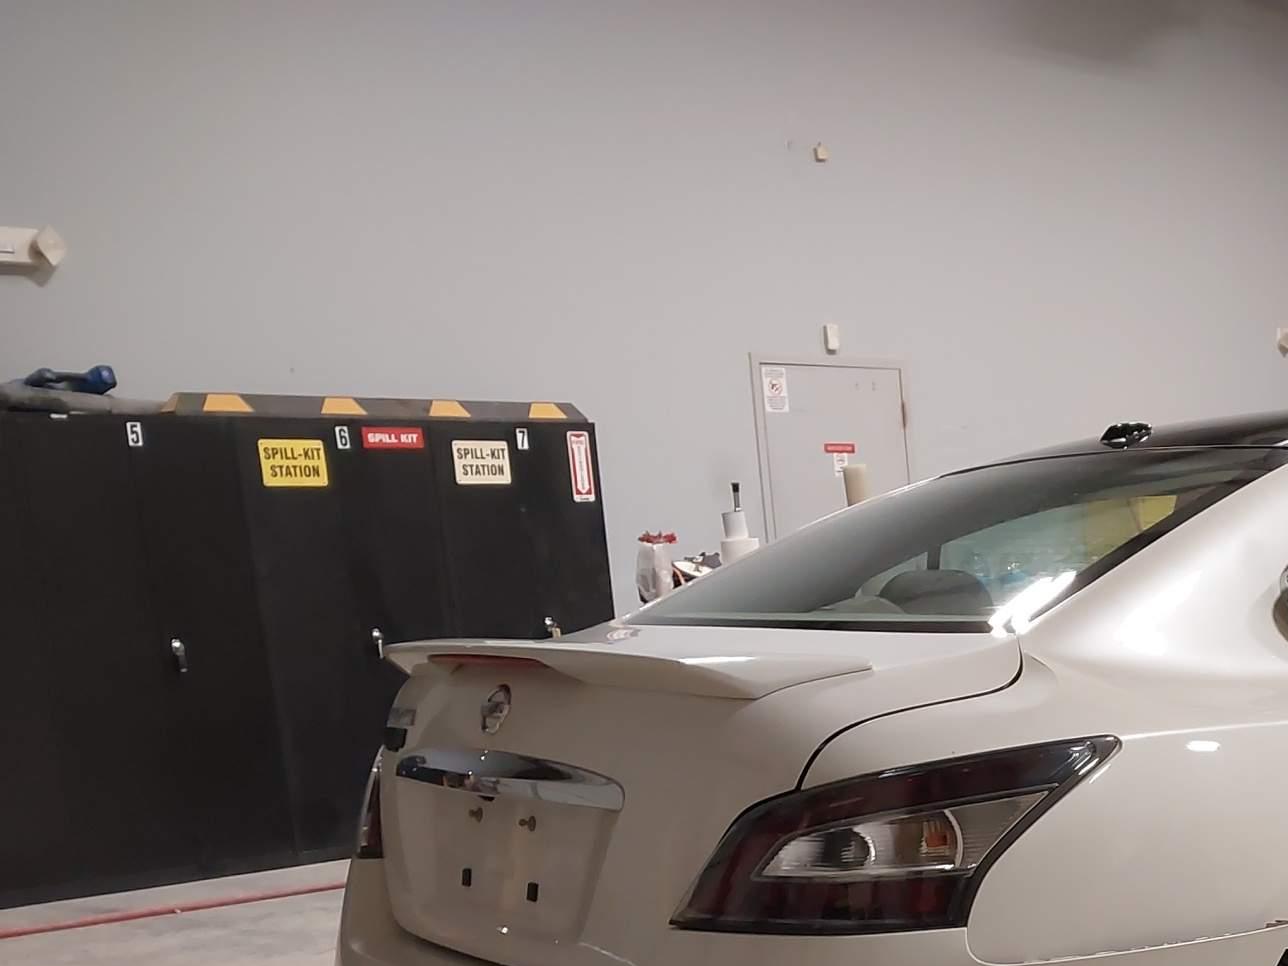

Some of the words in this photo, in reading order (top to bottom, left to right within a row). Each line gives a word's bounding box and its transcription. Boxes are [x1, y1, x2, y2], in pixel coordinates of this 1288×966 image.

[130, 423, 140, 445] 5
[338, 428, 349, 447] 6
[368, 433, 398, 443] SPILL
[400, 434, 418, 443] KIT
[518, 430, 526, 449] 7
[263, 446, 321, 460] SPILL-KIT
[457, 447, 505, 460] SPILL-KIT
[270, 464, 320, 478] STATION
[462, 463, 504, 476] STATION
